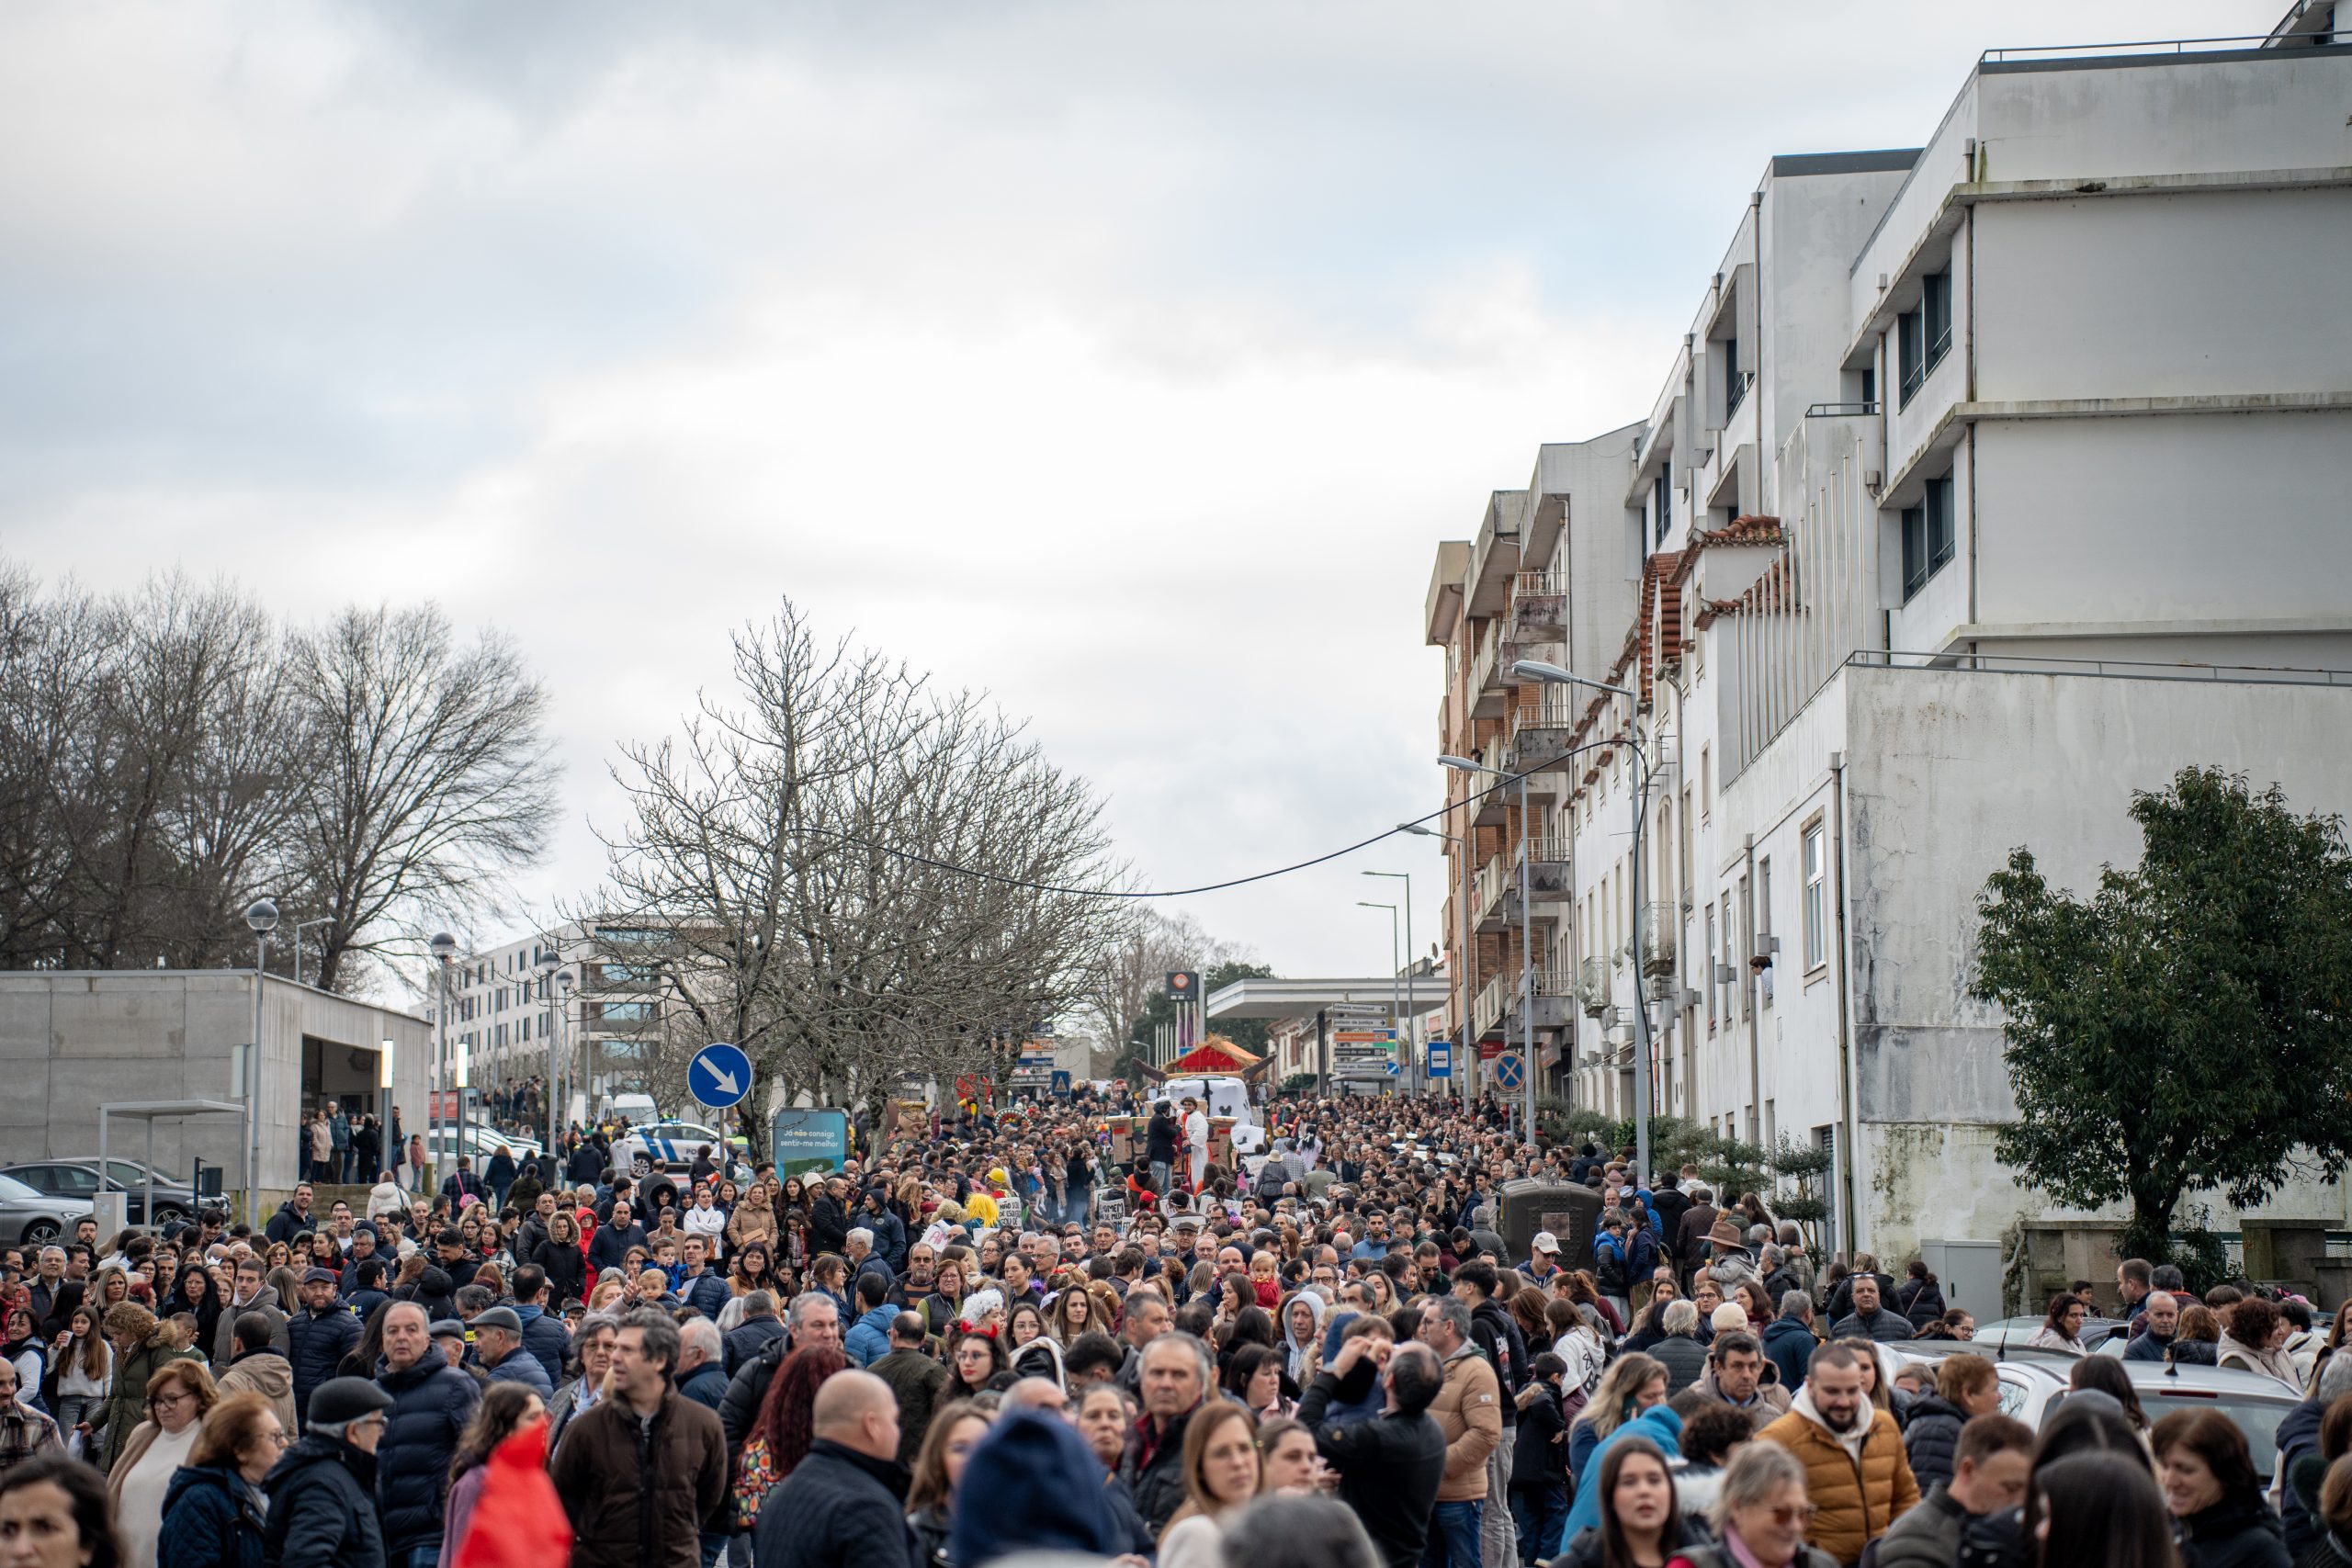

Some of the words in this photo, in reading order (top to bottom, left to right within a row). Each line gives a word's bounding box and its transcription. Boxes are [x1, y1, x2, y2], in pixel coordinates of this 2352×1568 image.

[808, 1130, 835, 1139] consigo
[780, 1139, 814, 1147] sentir-me
[999, 1201, 1012, 1210] NÃO
